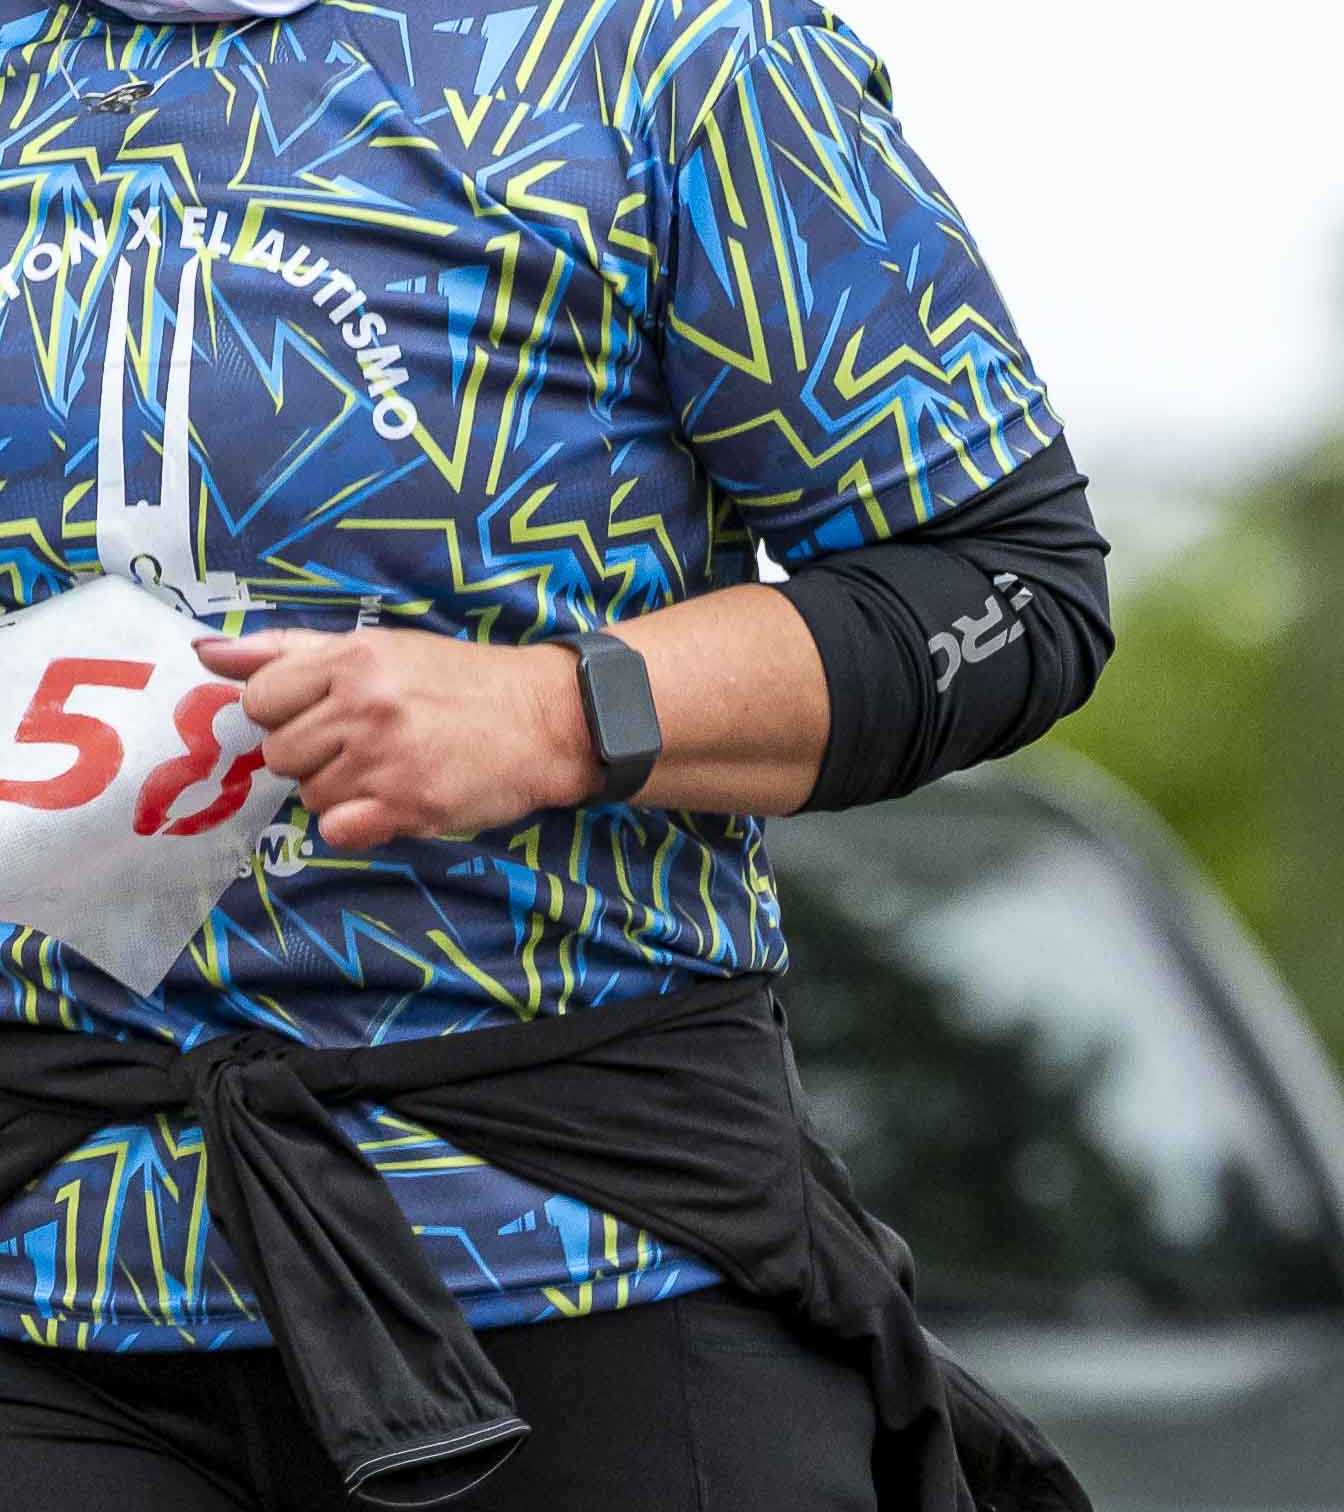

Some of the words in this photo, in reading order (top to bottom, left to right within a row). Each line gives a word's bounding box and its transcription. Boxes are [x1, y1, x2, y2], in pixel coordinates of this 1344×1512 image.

[127, 208, 162, 251] X
[180, 206, 231, 257] EL
[246, 229, 418, 441] AUTISMO
